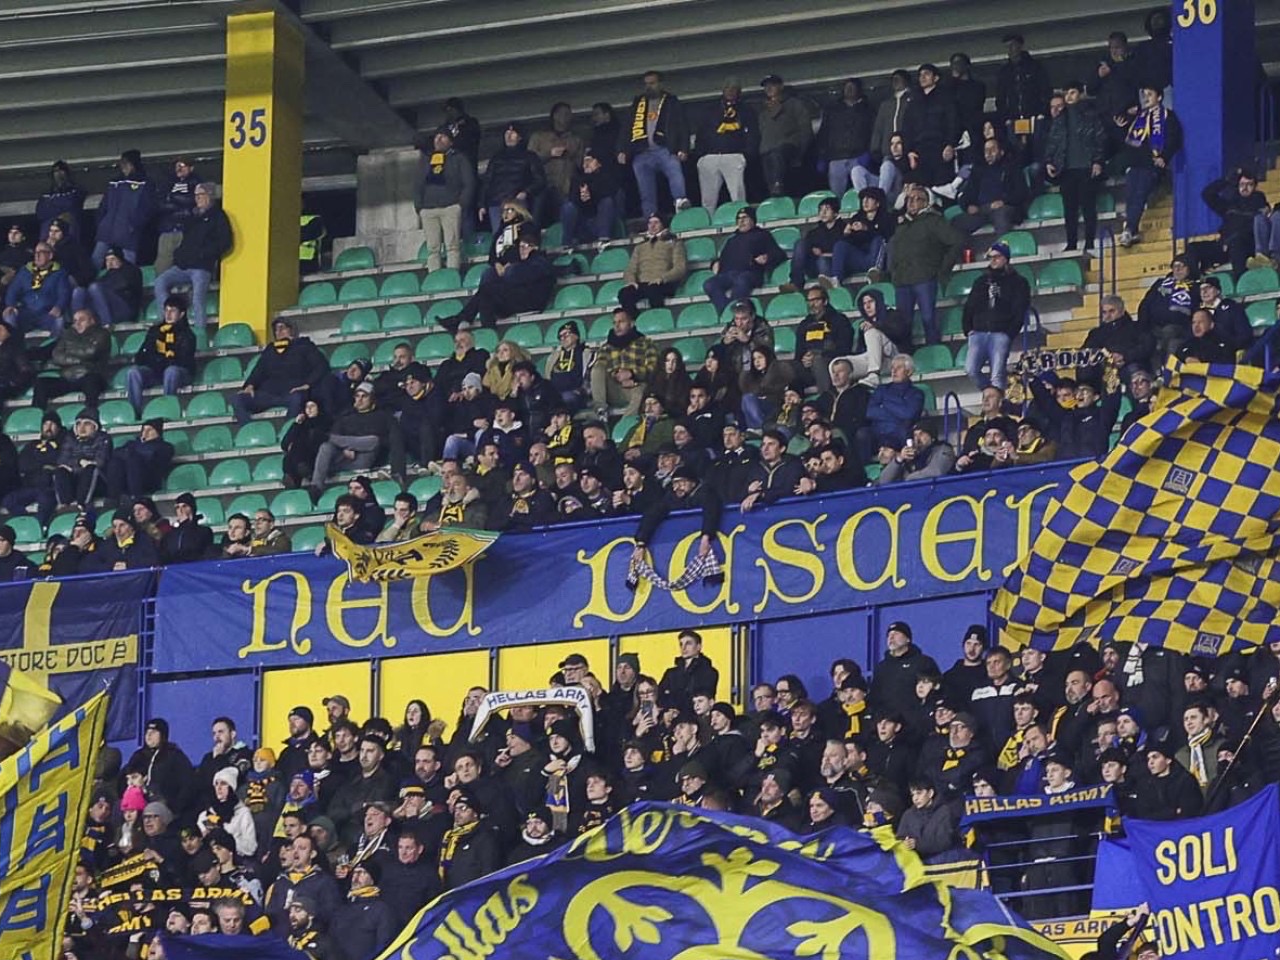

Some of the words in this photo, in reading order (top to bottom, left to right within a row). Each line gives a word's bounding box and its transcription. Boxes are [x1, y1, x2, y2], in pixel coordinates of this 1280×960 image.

[229, 107, 267, 149] 35
[487, 690, 547, 708] HELLAS
[963, 799, 1038, 816] HELLAS
[1155, 827, 1238, 887] SOLI
